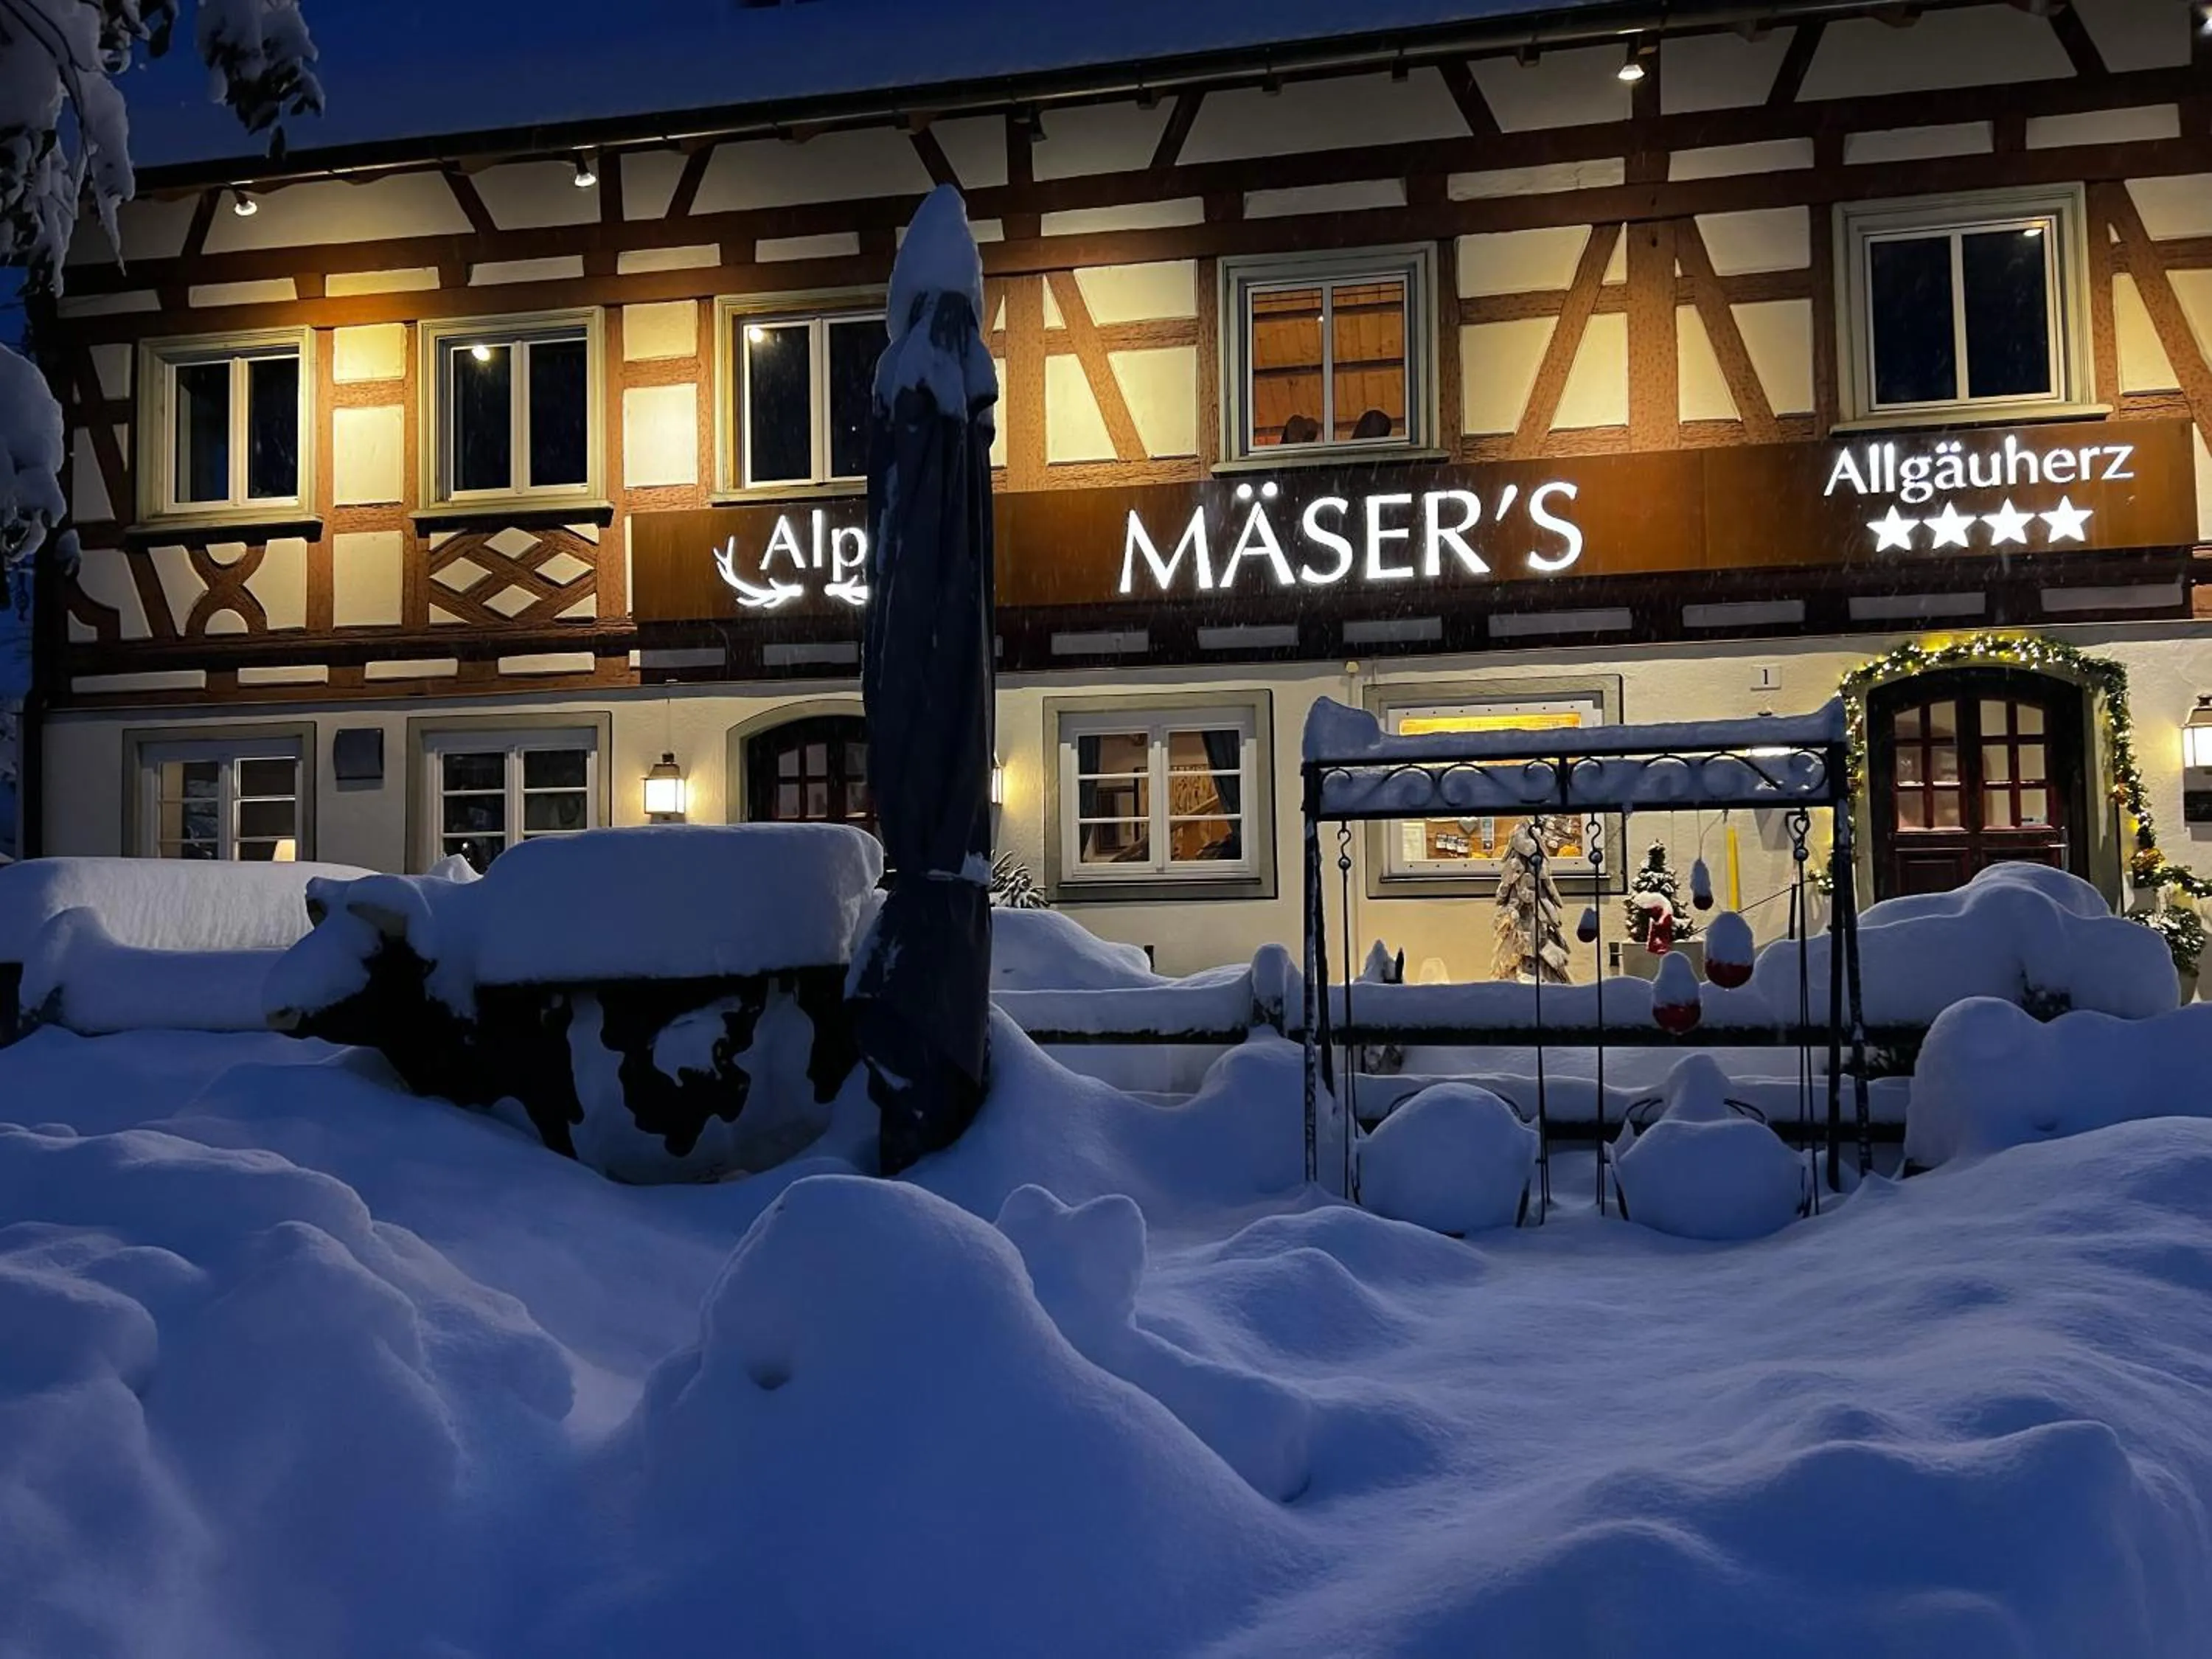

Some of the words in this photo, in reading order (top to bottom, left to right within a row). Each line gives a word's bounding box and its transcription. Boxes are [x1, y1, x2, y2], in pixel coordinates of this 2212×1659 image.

[1823, 434, 2134, 504] Allgäuherz
[1119, 481, 1582, 592] MÄSER'S
[1762, 669, 1769, 685] 1
